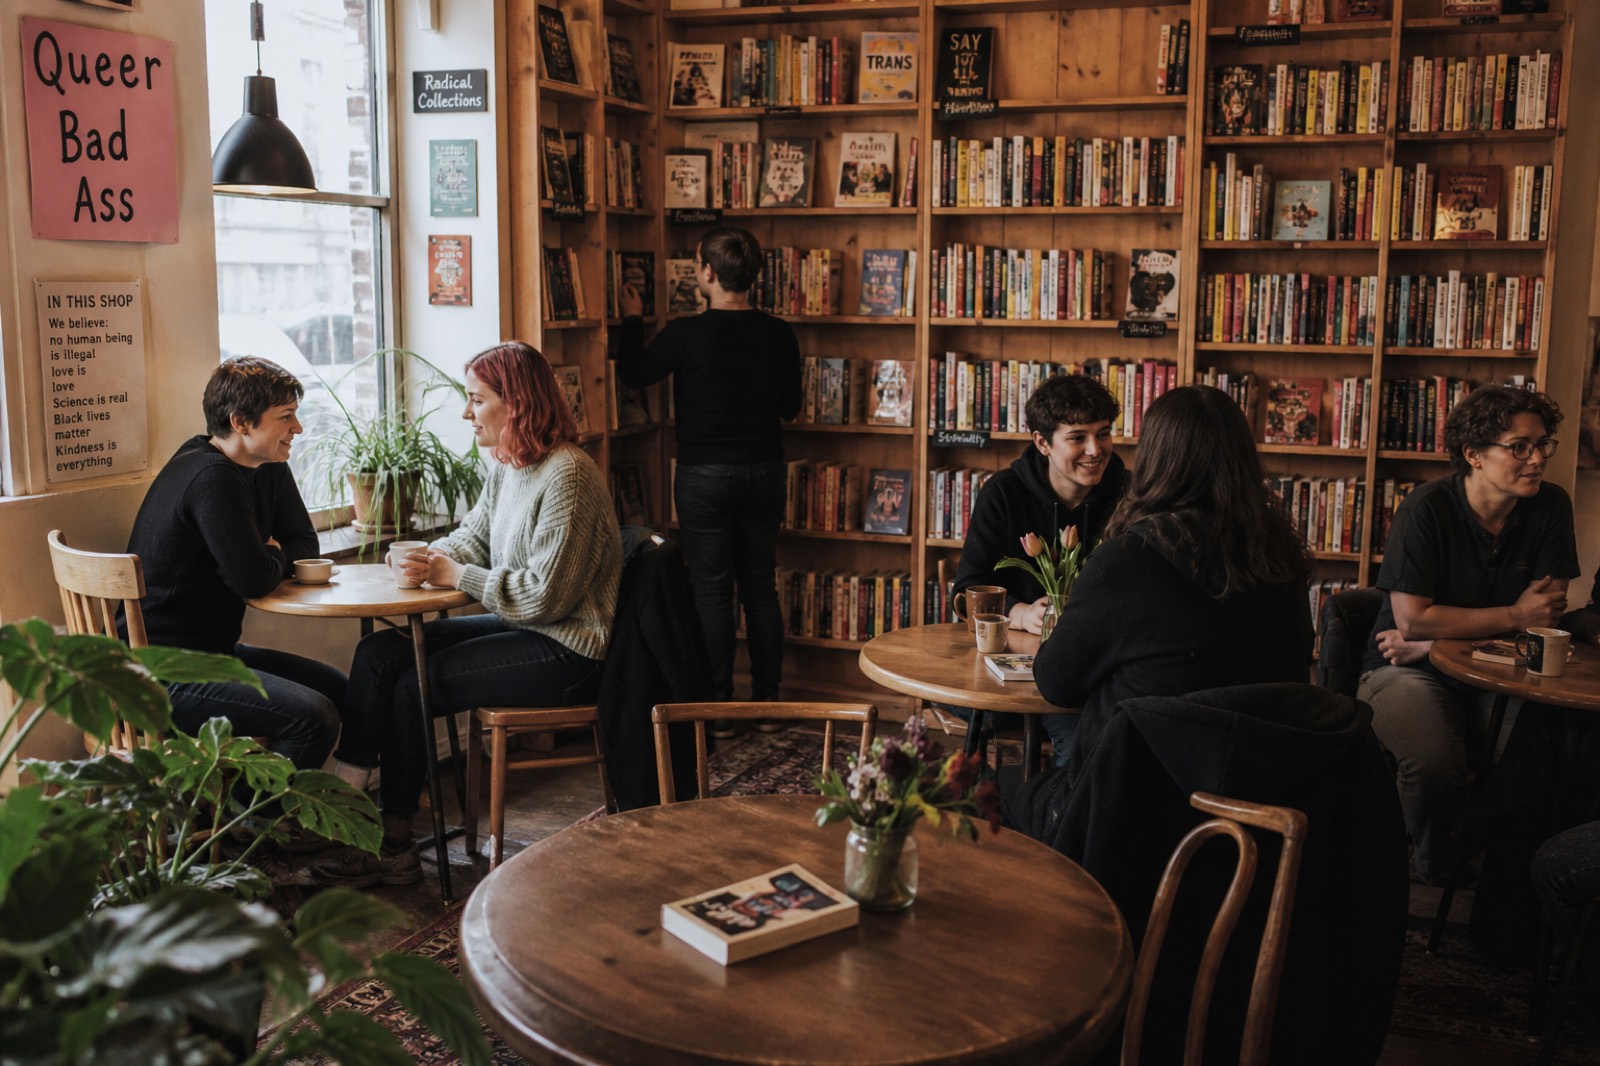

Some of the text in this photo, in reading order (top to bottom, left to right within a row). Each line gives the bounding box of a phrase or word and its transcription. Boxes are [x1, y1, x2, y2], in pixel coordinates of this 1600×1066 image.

[950, 33, 982, 51] SAY
[33, 30, 162, 96] Queer
[866, 54, 913, 71] TRANS
[424, 73, 473, 91] Radical
[417, 92, 482, 109] Collections
[59, 108, 128, 163] Bad
[73, 175, 134, 223] Ass
[47, 294, 133, 309] IN THIS SHOP
[49, 317, 109, 329] We believe:
[50, 333, 133, 346] no human being
[51, 349, 96, 362] is illegal
[51, 365, 86, 377] love is
[52, 382, 75, 393] love
[53, 392, 128, 409] Science is real
[54, 411, 111, 425] Black lives
[55, 427, 91, 440] matter
[56, 439, 117, 456] Kindness is
[56, 455, 113, 471] everything
